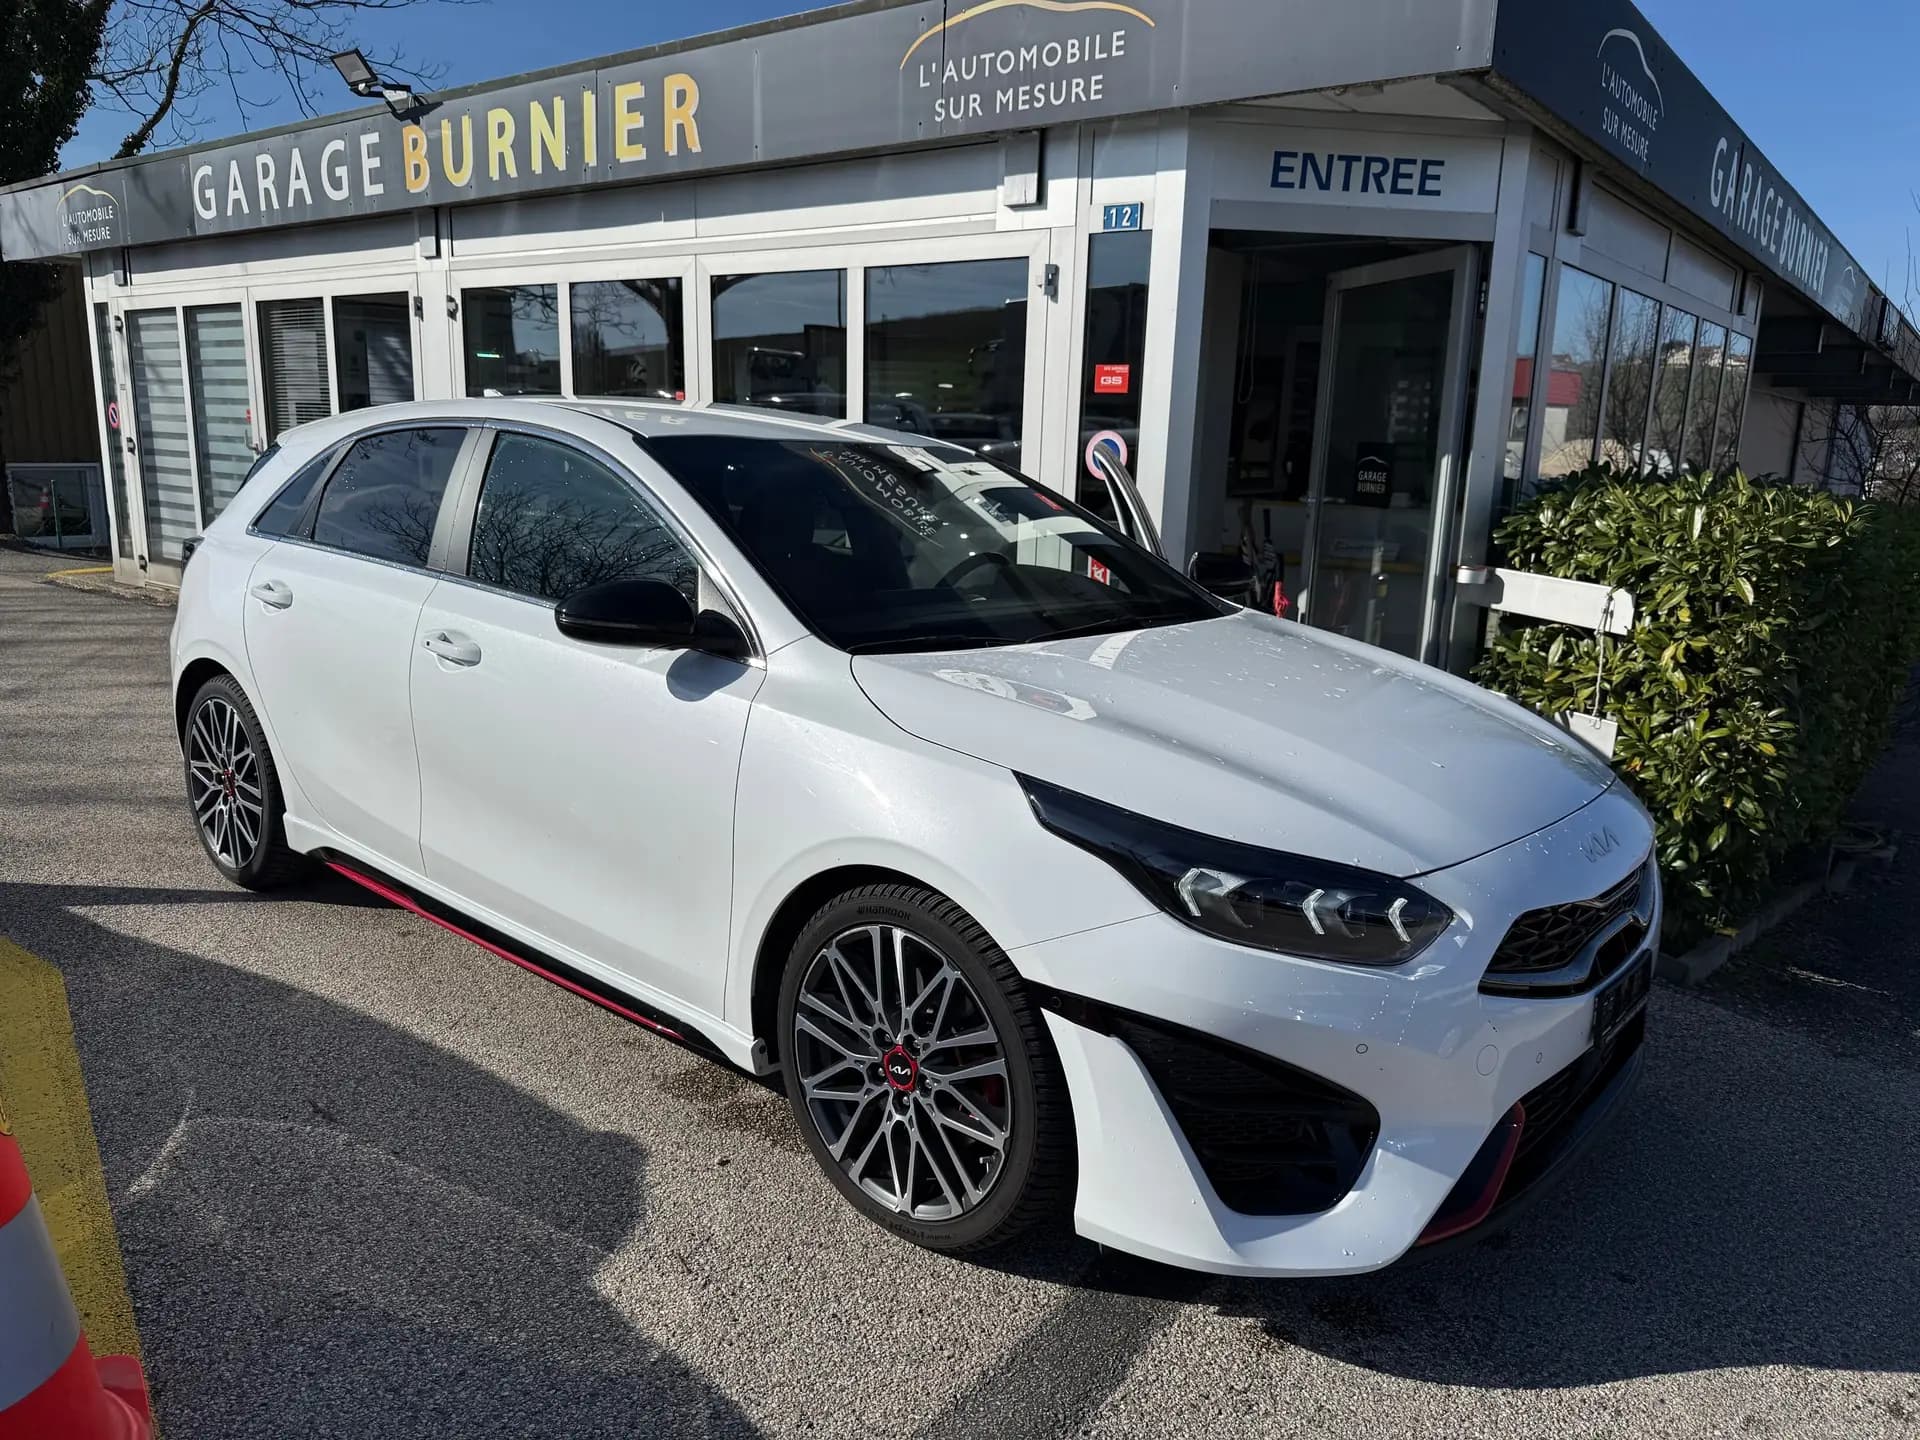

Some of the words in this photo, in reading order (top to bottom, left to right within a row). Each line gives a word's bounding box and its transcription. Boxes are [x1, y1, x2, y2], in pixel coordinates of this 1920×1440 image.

[919, 29, 1126, 88] L'AUTOMOBILE
[934, 93, 983, 122] SUR
[995, 74, 1104, 114] MESURE
[1601, 61, 1658, 131] L'AUTOMOBILE
[193, 131, 384, 220] GARAGE
[402, 73, 702, 193] BURNIER
[1602, 105, 1619, 139] SUR
[1620, 121, 1649, 162] MESURE
[1270, 150, 1445, 197] ENTREE
[61, 205, 114, 227] L'AUTOMOBILE
[67, 231, 82, 246] SUR
[83, 226, 111, 243] MESURE
[1109, 206, 1131, 228] 12
[1710, 137, 1784, 254] GARAGE
[1779, 206, 1829, 296] BURNIER
[1358, 470, 1387, 482] GARAGE
